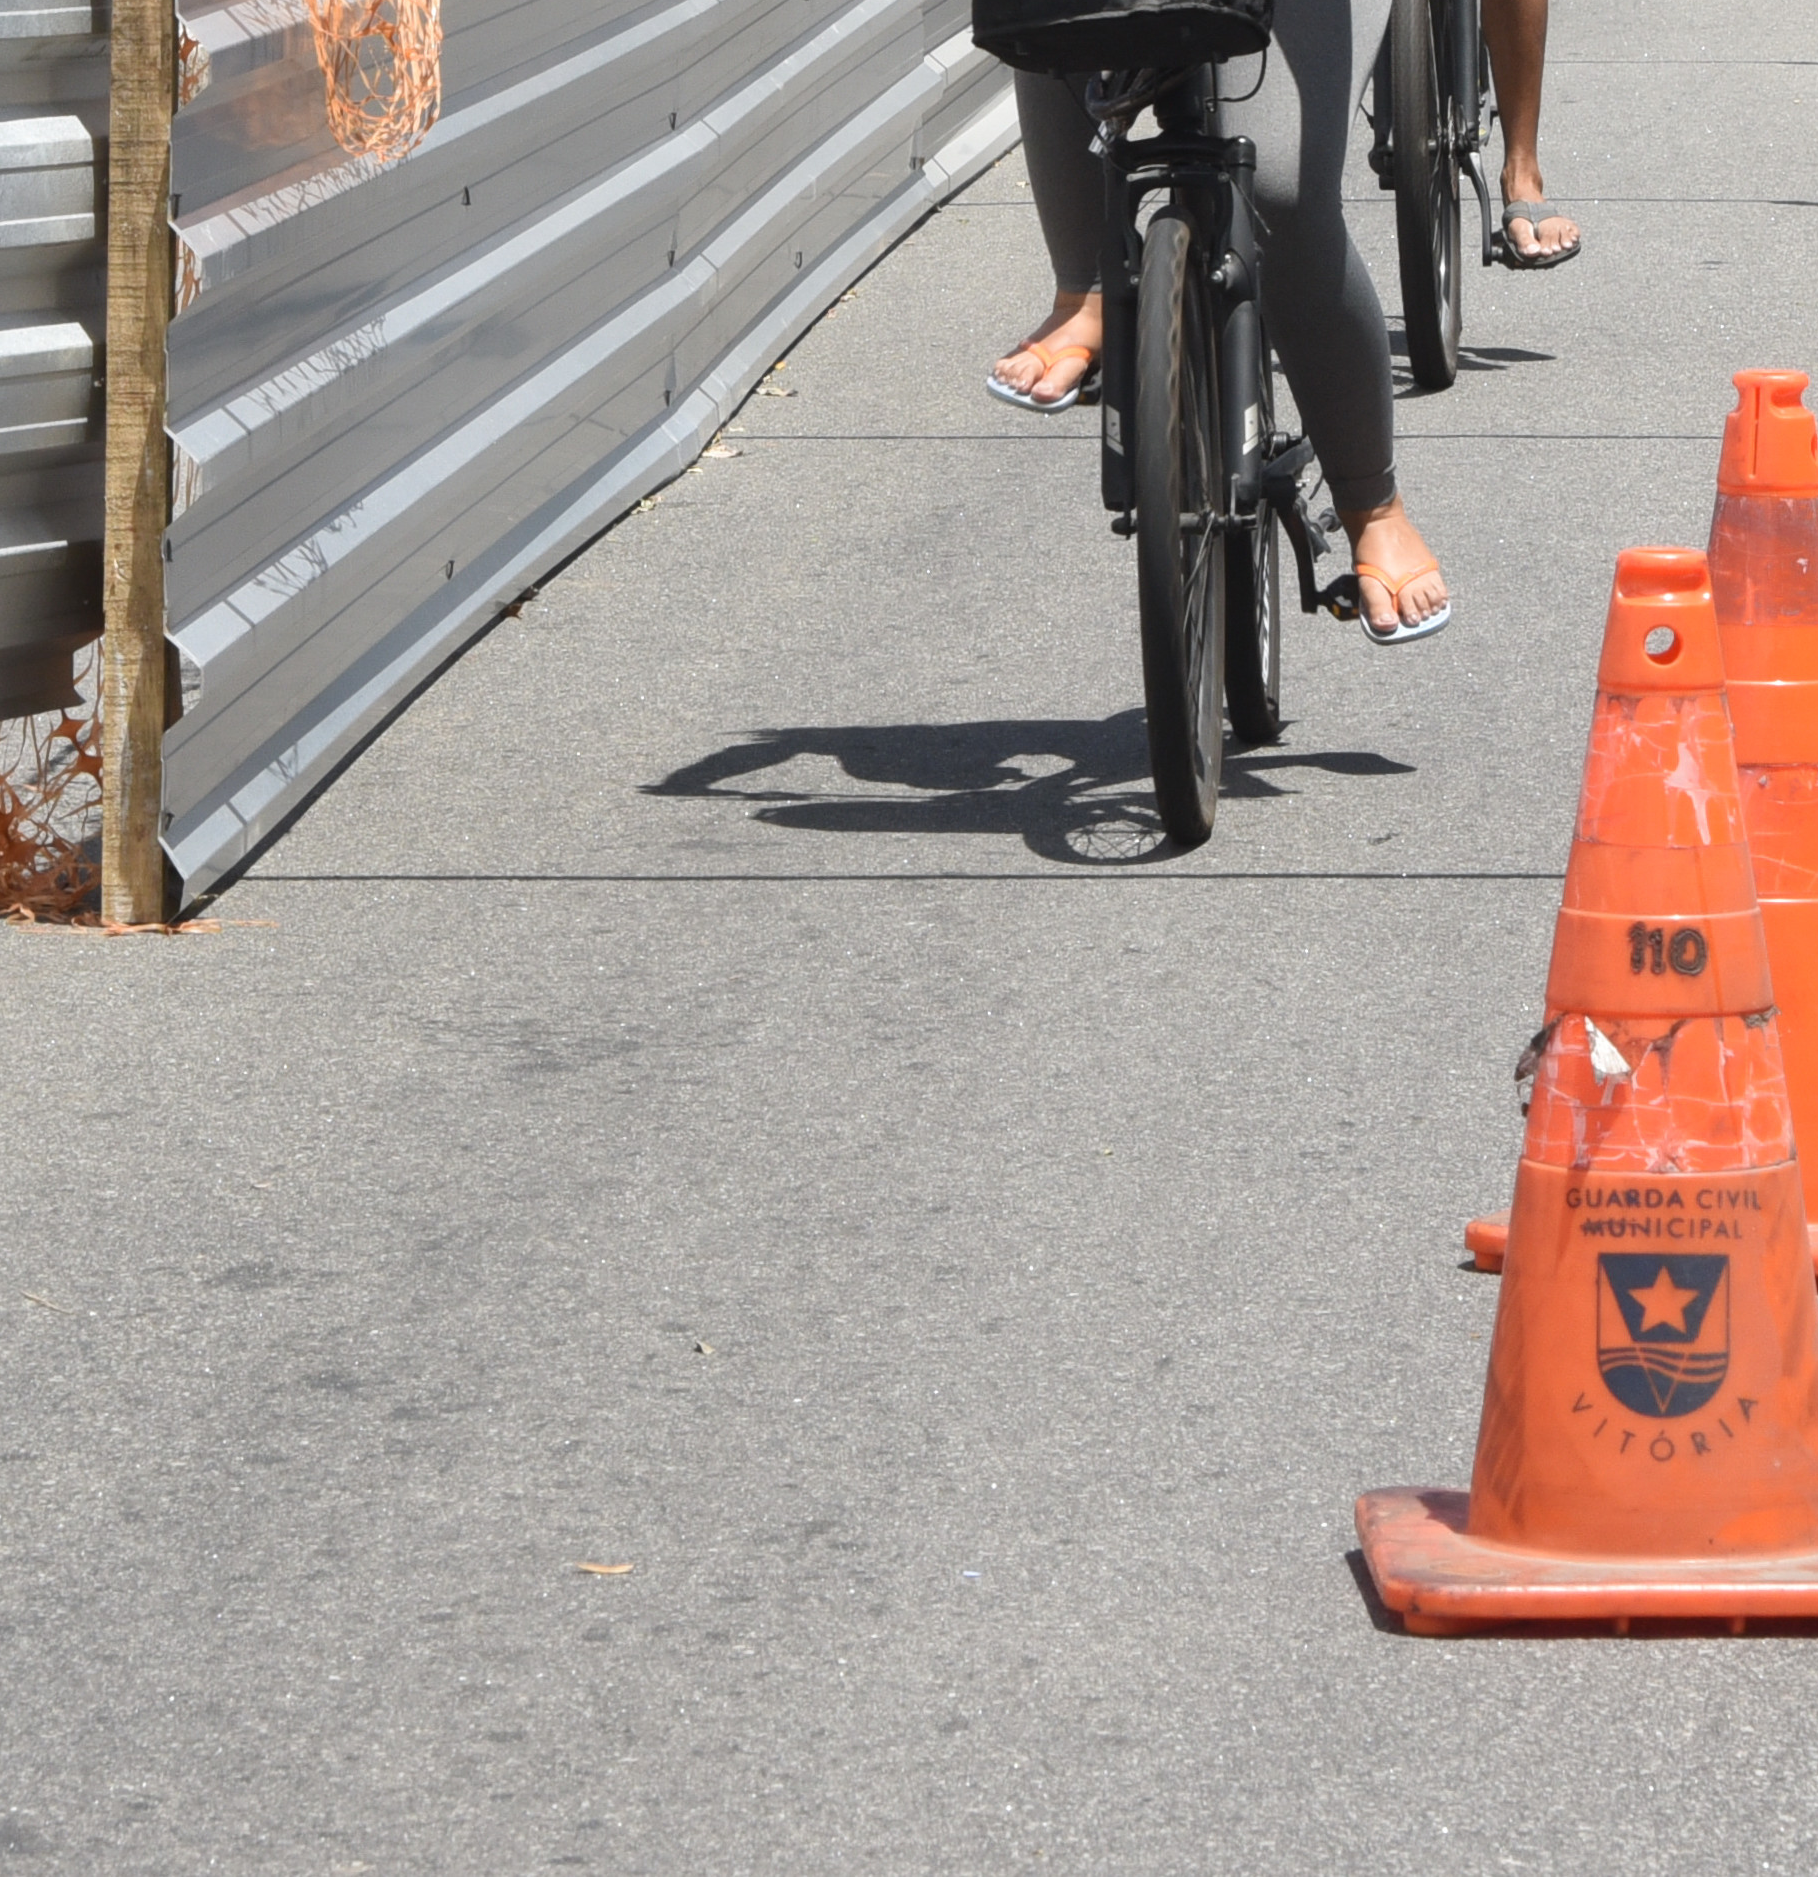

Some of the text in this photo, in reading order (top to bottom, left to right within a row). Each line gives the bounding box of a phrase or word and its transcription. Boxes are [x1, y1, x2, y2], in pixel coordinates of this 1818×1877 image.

[1566, 1187, 1762, 1211] GUARDA CIVIL
[1582, 1216, 1743, 1239] MUNICIPAL
[1571, 1392, 1759, 1462] VITÓRIA
